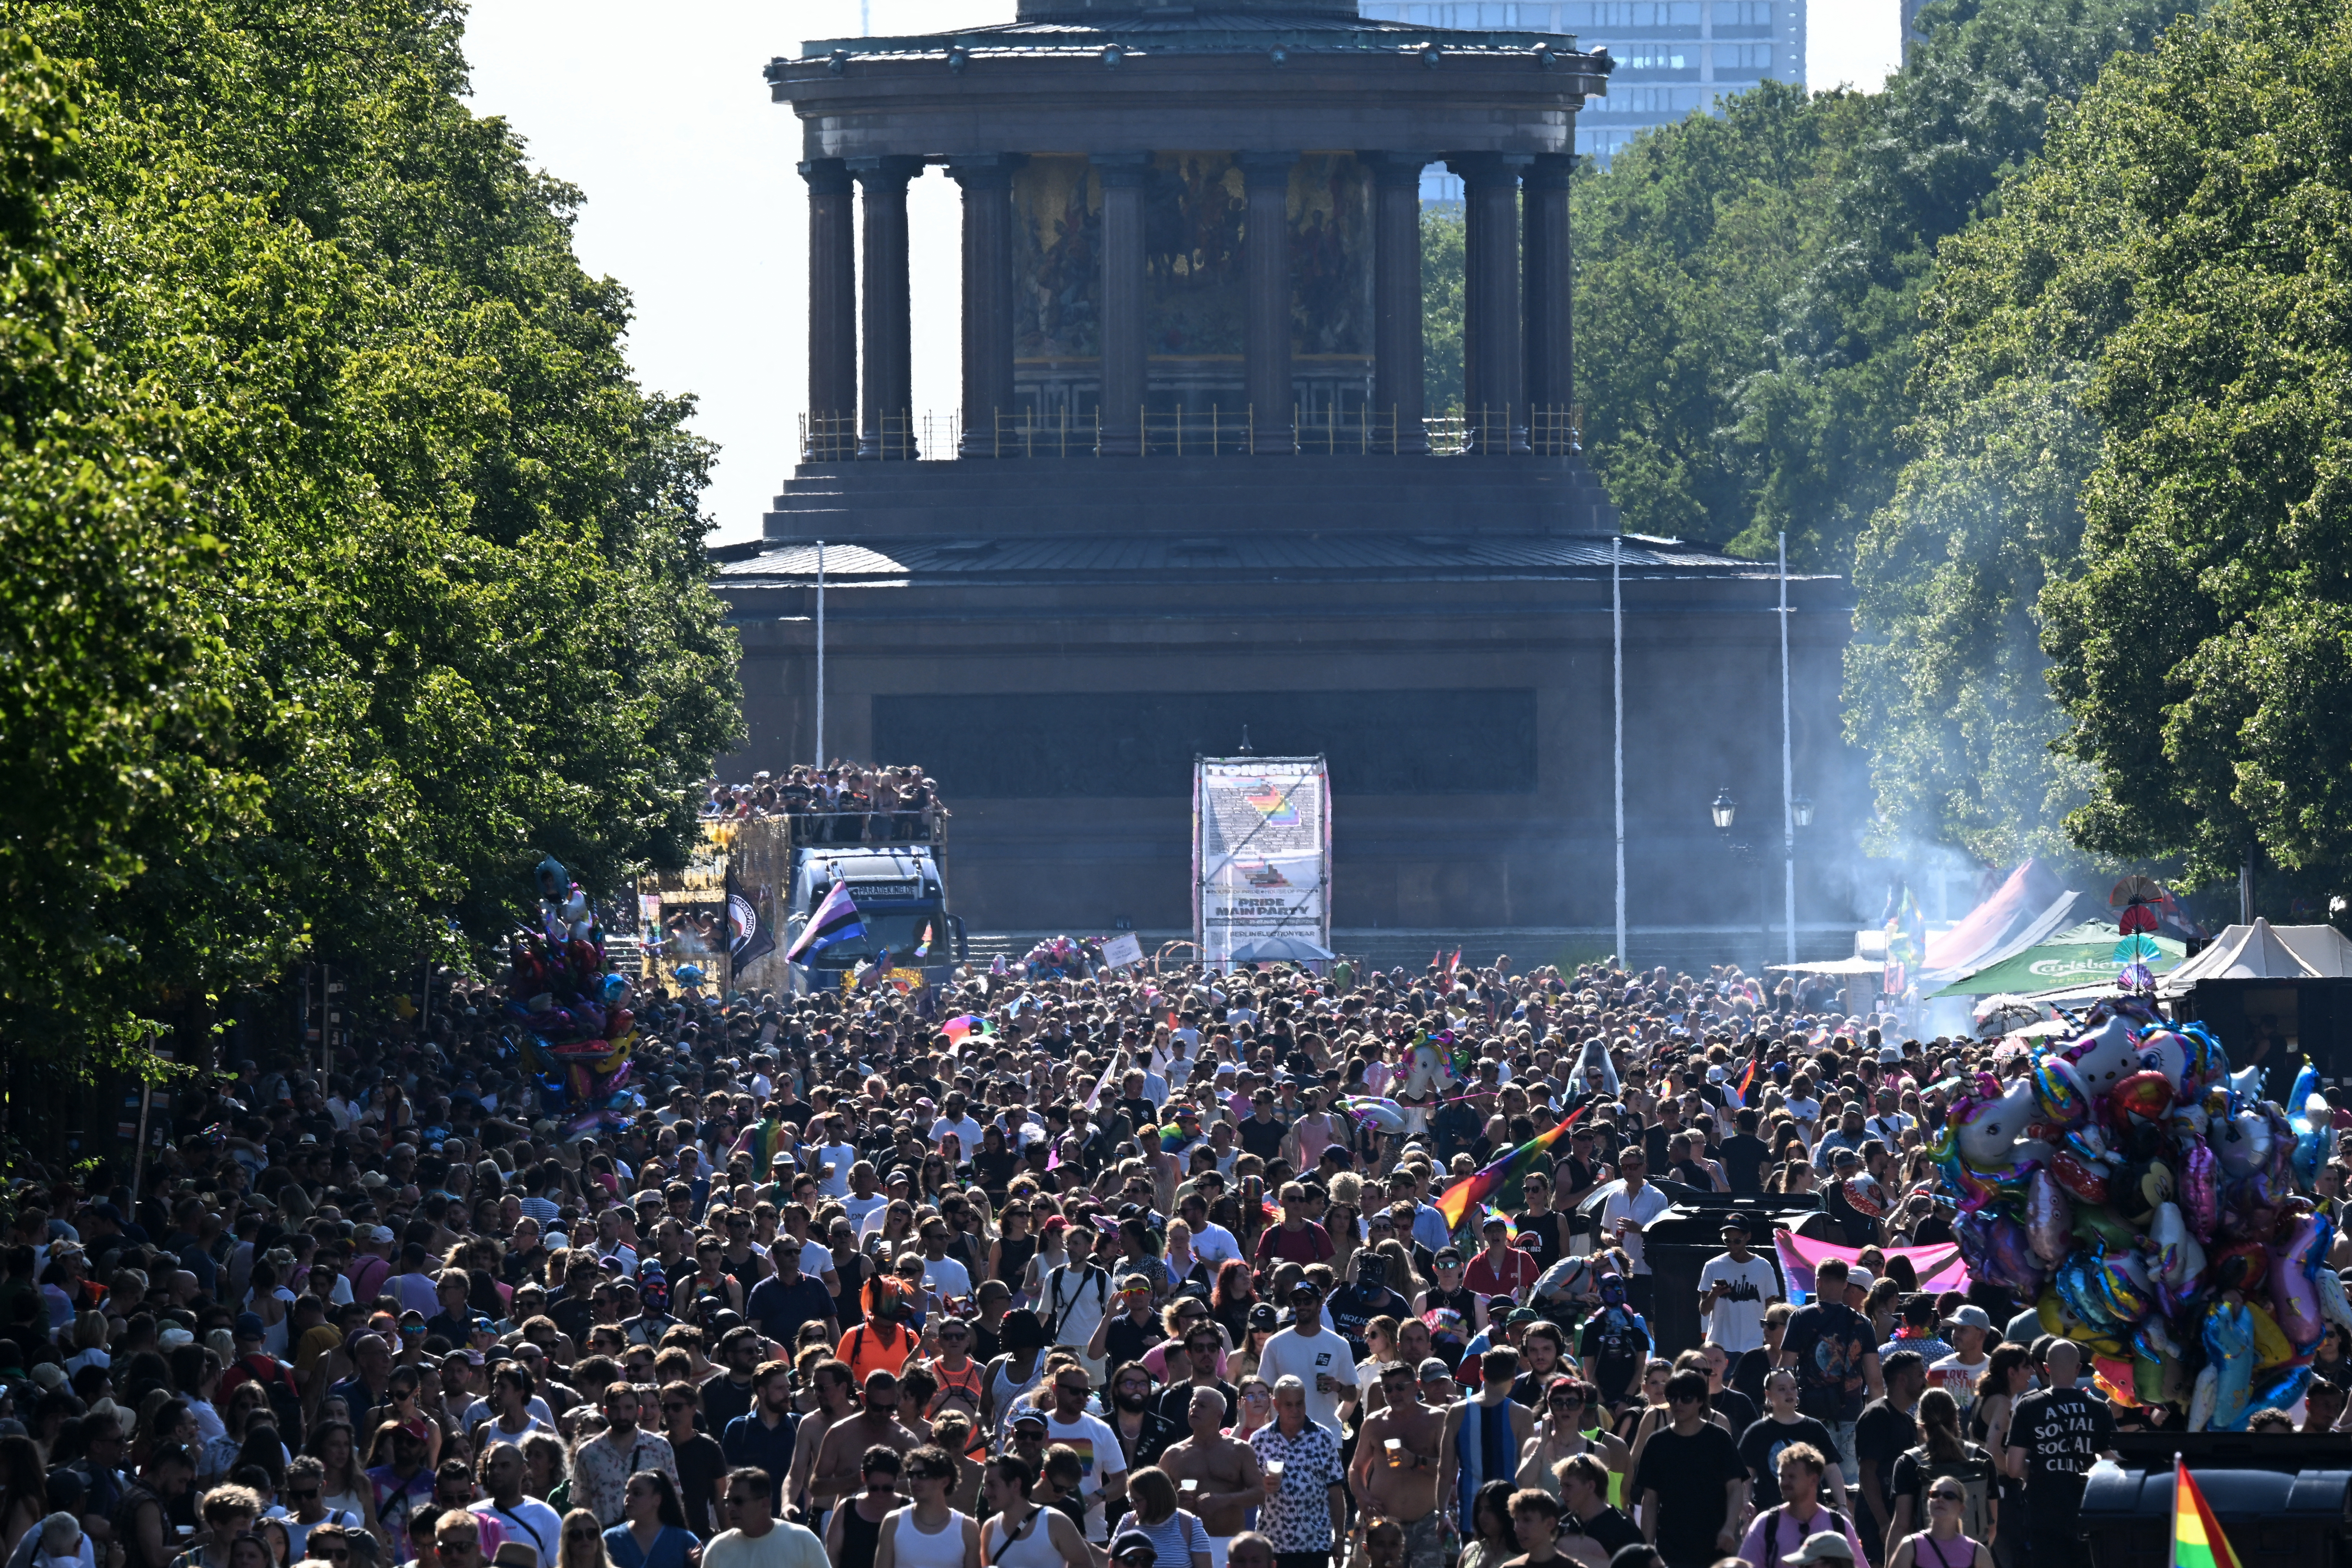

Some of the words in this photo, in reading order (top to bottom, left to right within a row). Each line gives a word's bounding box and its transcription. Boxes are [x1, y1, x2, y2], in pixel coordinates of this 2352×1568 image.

[1238, 898, 1284, 907] PRIDE
[1216, 907, 1255, 916] MAIN
[1257, 906, 1309, 915] PARTY
[1340, 1314, 1370, 1326] NAUG
[2045, 1403, 2086, 1420] ANTI
